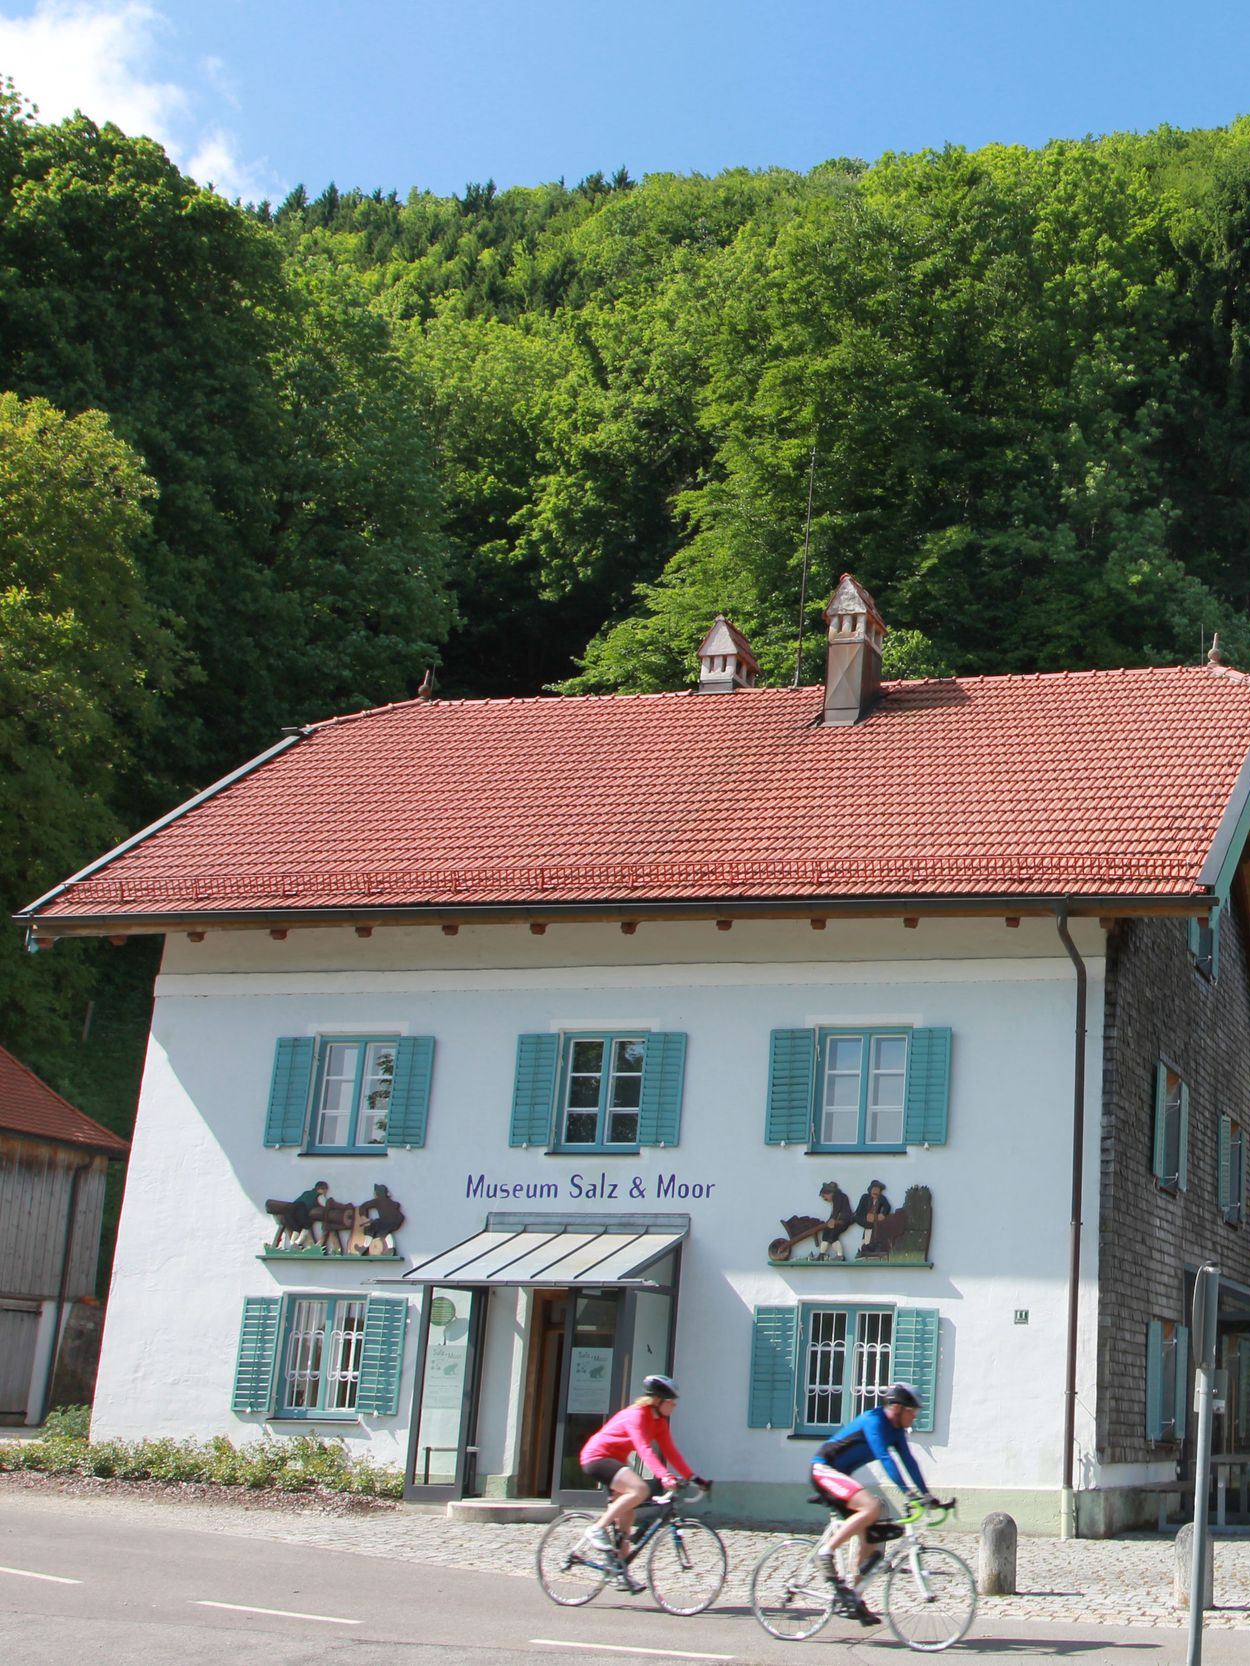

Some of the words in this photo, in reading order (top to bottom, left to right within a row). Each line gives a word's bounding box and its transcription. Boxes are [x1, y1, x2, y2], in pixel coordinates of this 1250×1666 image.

[466, 1173, 558, 1199] Museum
[569, 1172, 619, 1199] Salz
[628, 1175, 647, 1199] &
[656, 1173, 716, 1199] Moor
